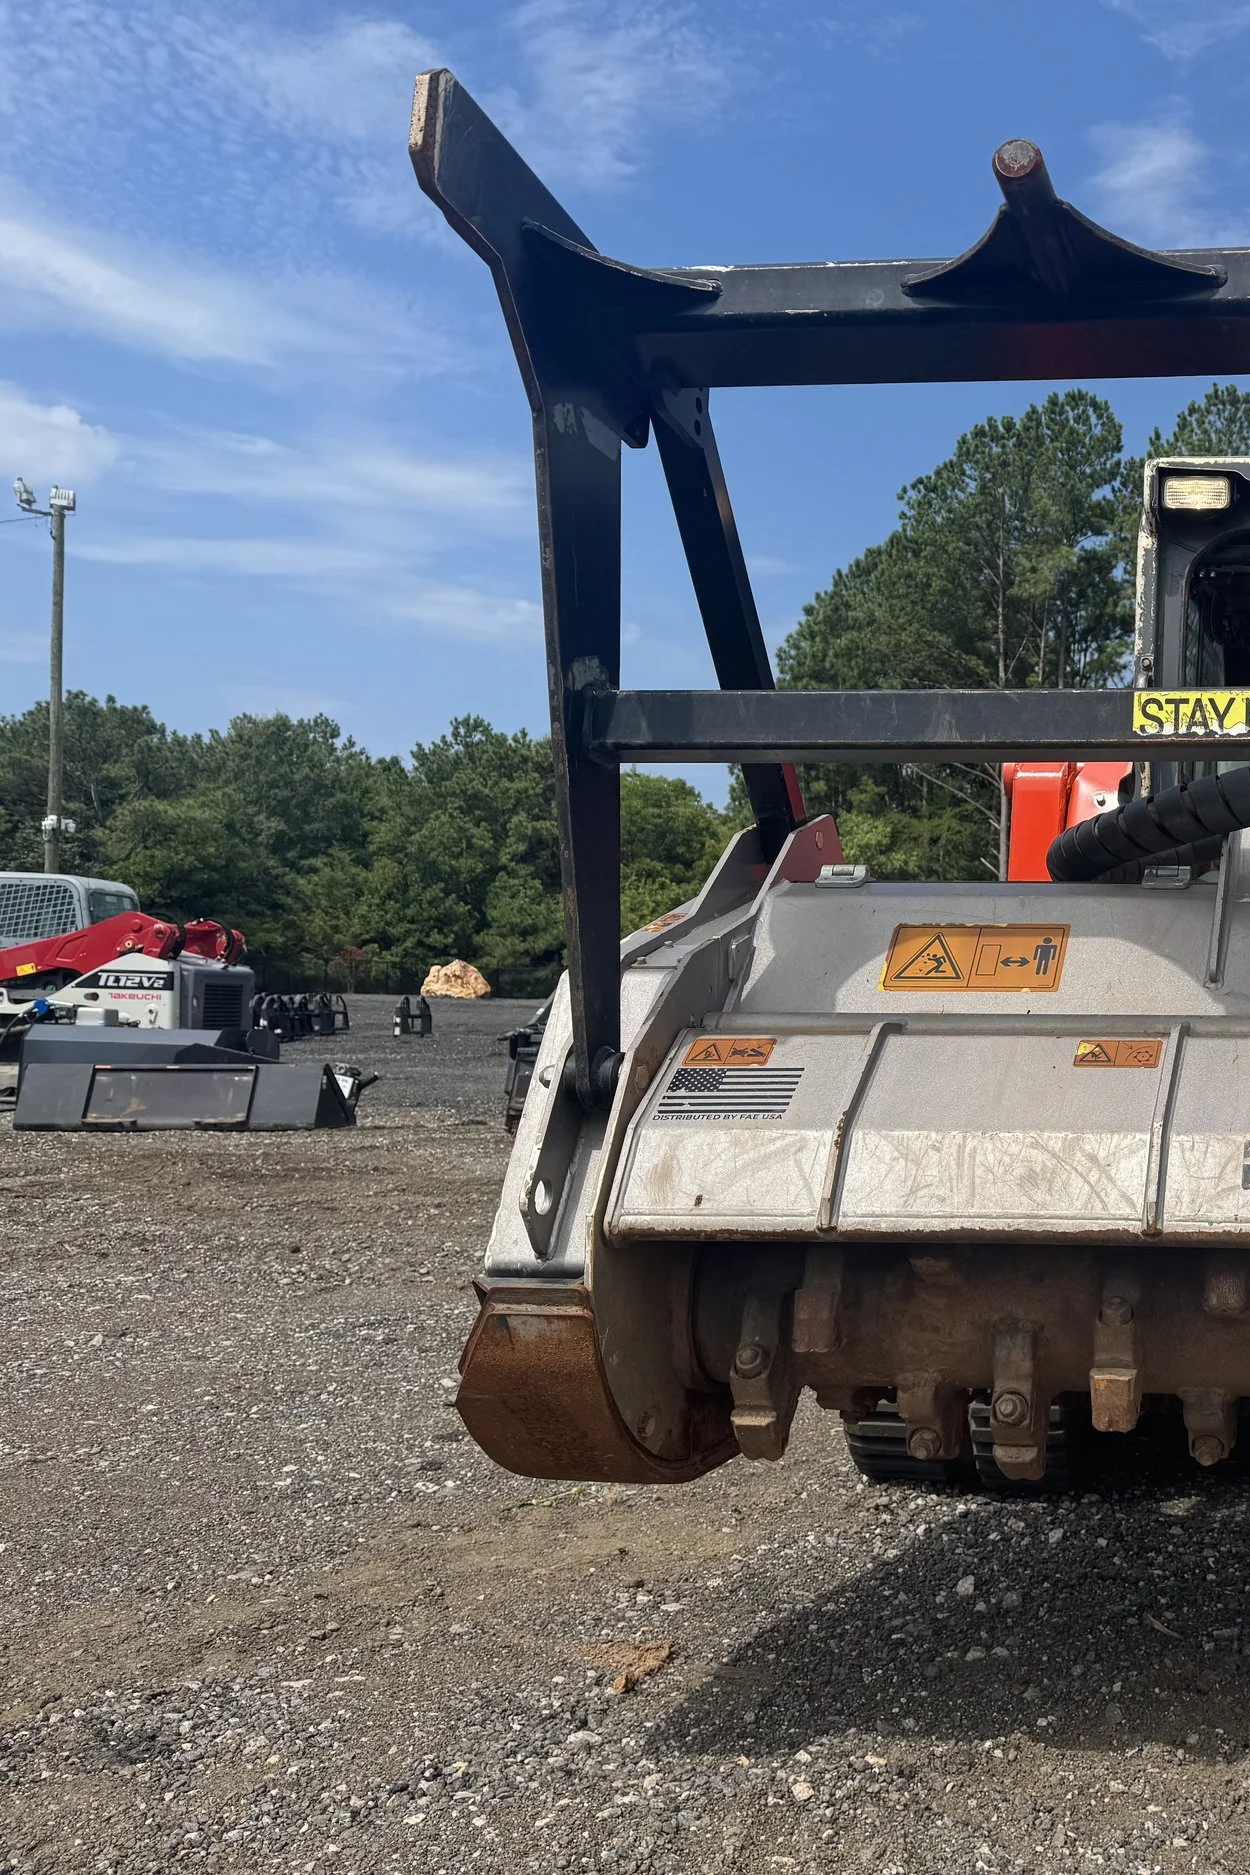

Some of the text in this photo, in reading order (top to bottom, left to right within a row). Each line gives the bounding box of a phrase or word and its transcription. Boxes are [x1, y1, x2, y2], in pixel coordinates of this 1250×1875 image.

[1141, 698, 1235, 734] STAY
[98, 972, 167, 988] TL12V2
[108, 992, 161, 1000] TAKEUCHI
